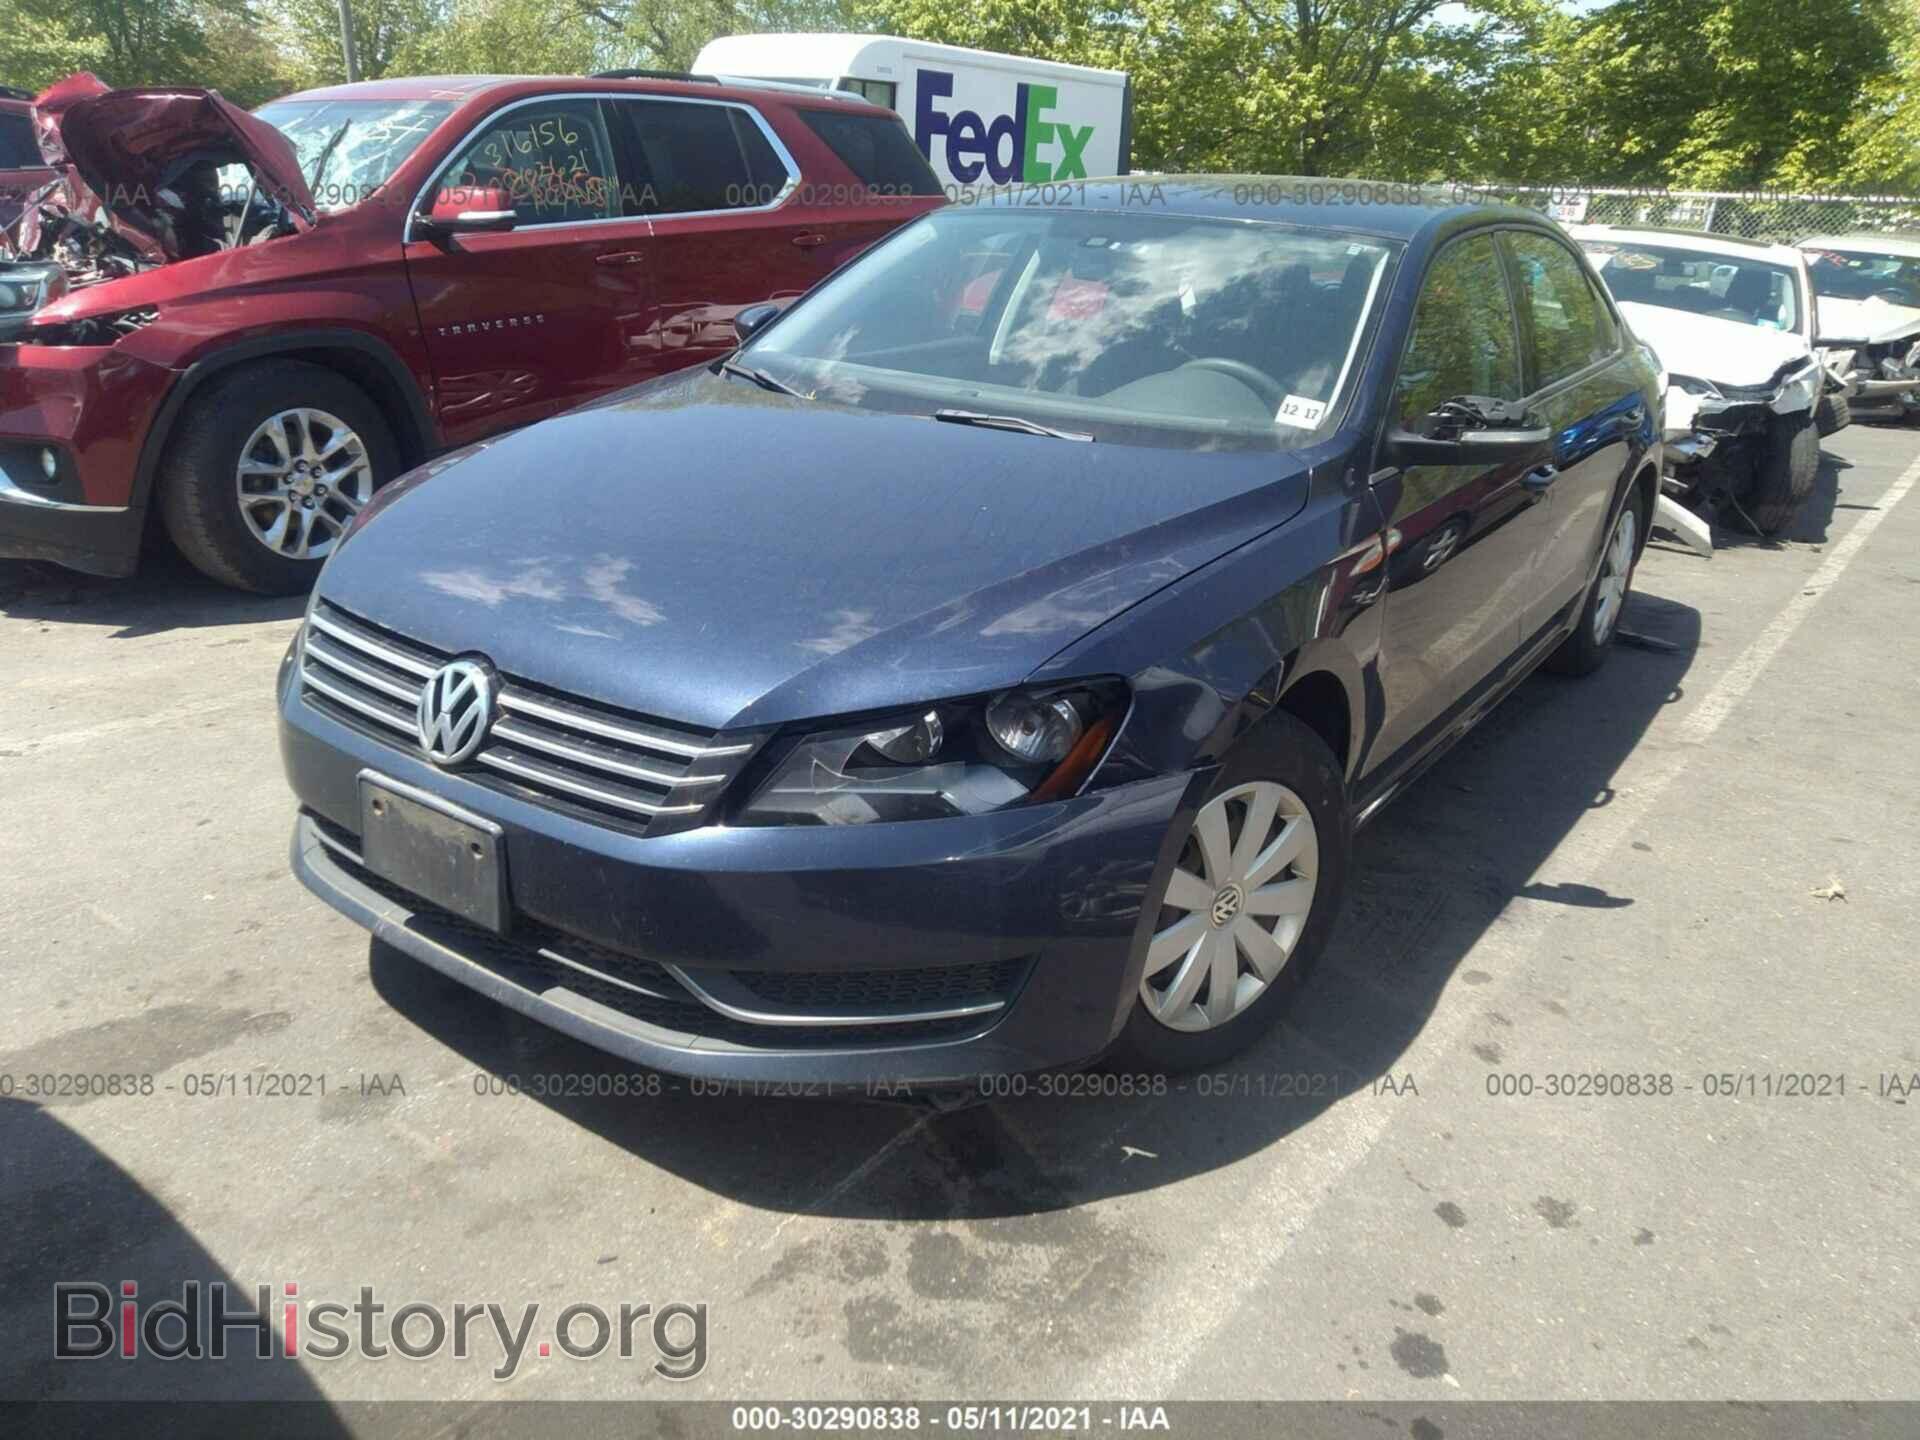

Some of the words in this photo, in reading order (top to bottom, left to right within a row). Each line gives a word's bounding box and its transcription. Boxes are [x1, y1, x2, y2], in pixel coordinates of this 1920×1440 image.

[484, 117, 579, 167] 316156
[915, 69, 1095, 185] FedEx
[1282, 402, 1299, 416] 12
[1303, 408, 1320, 420] 17
